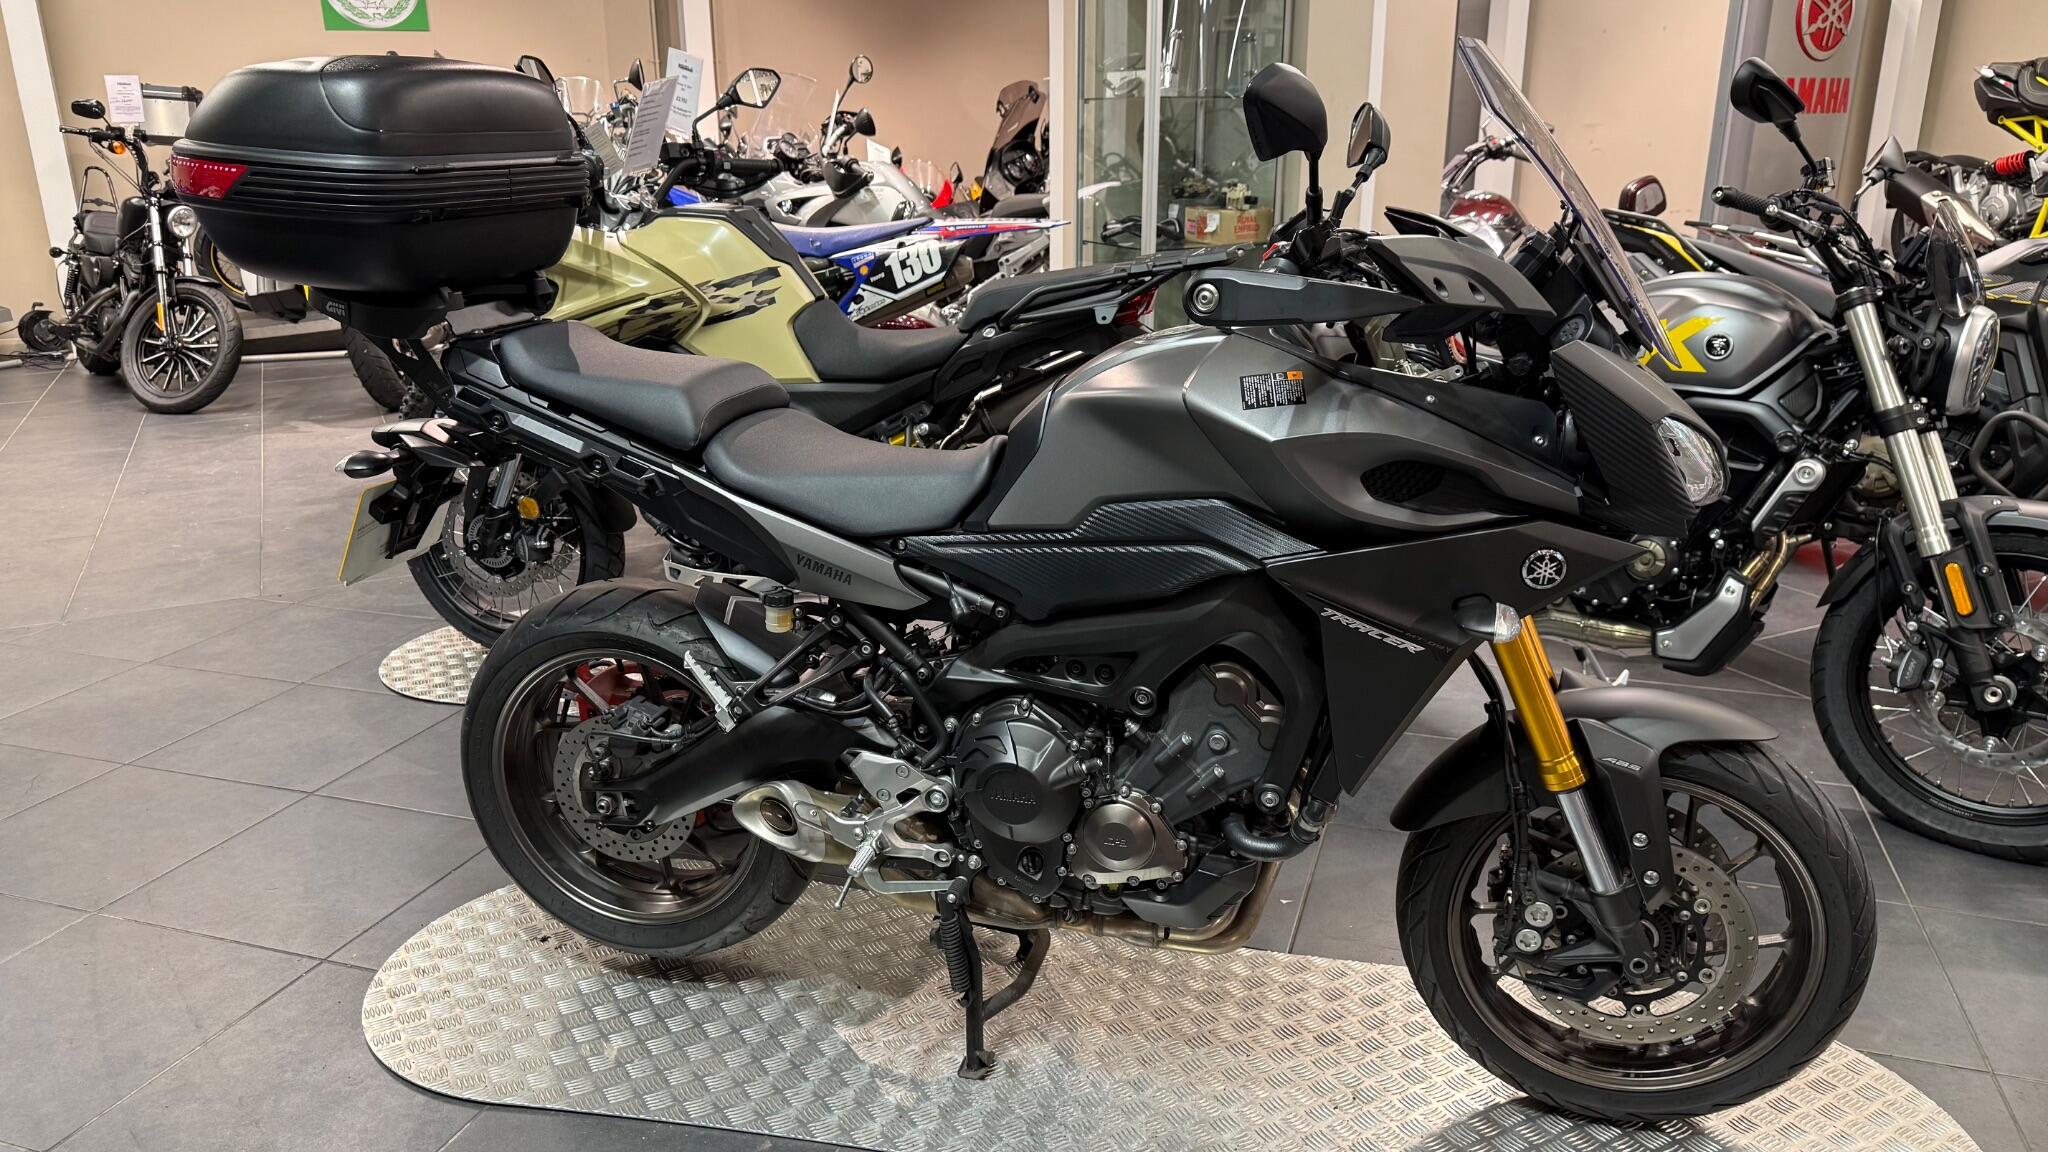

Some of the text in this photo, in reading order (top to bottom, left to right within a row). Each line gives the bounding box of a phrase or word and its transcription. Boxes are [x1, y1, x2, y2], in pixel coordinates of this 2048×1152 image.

[1786, 77, 1850, 114] MAHA
[884, 239, 943, 290] 130
[796, 552, 853, 586] YAMAHA
[1320, 606, 1426, 654] TRACER
[1601, 757, 1642, 771] ABS
